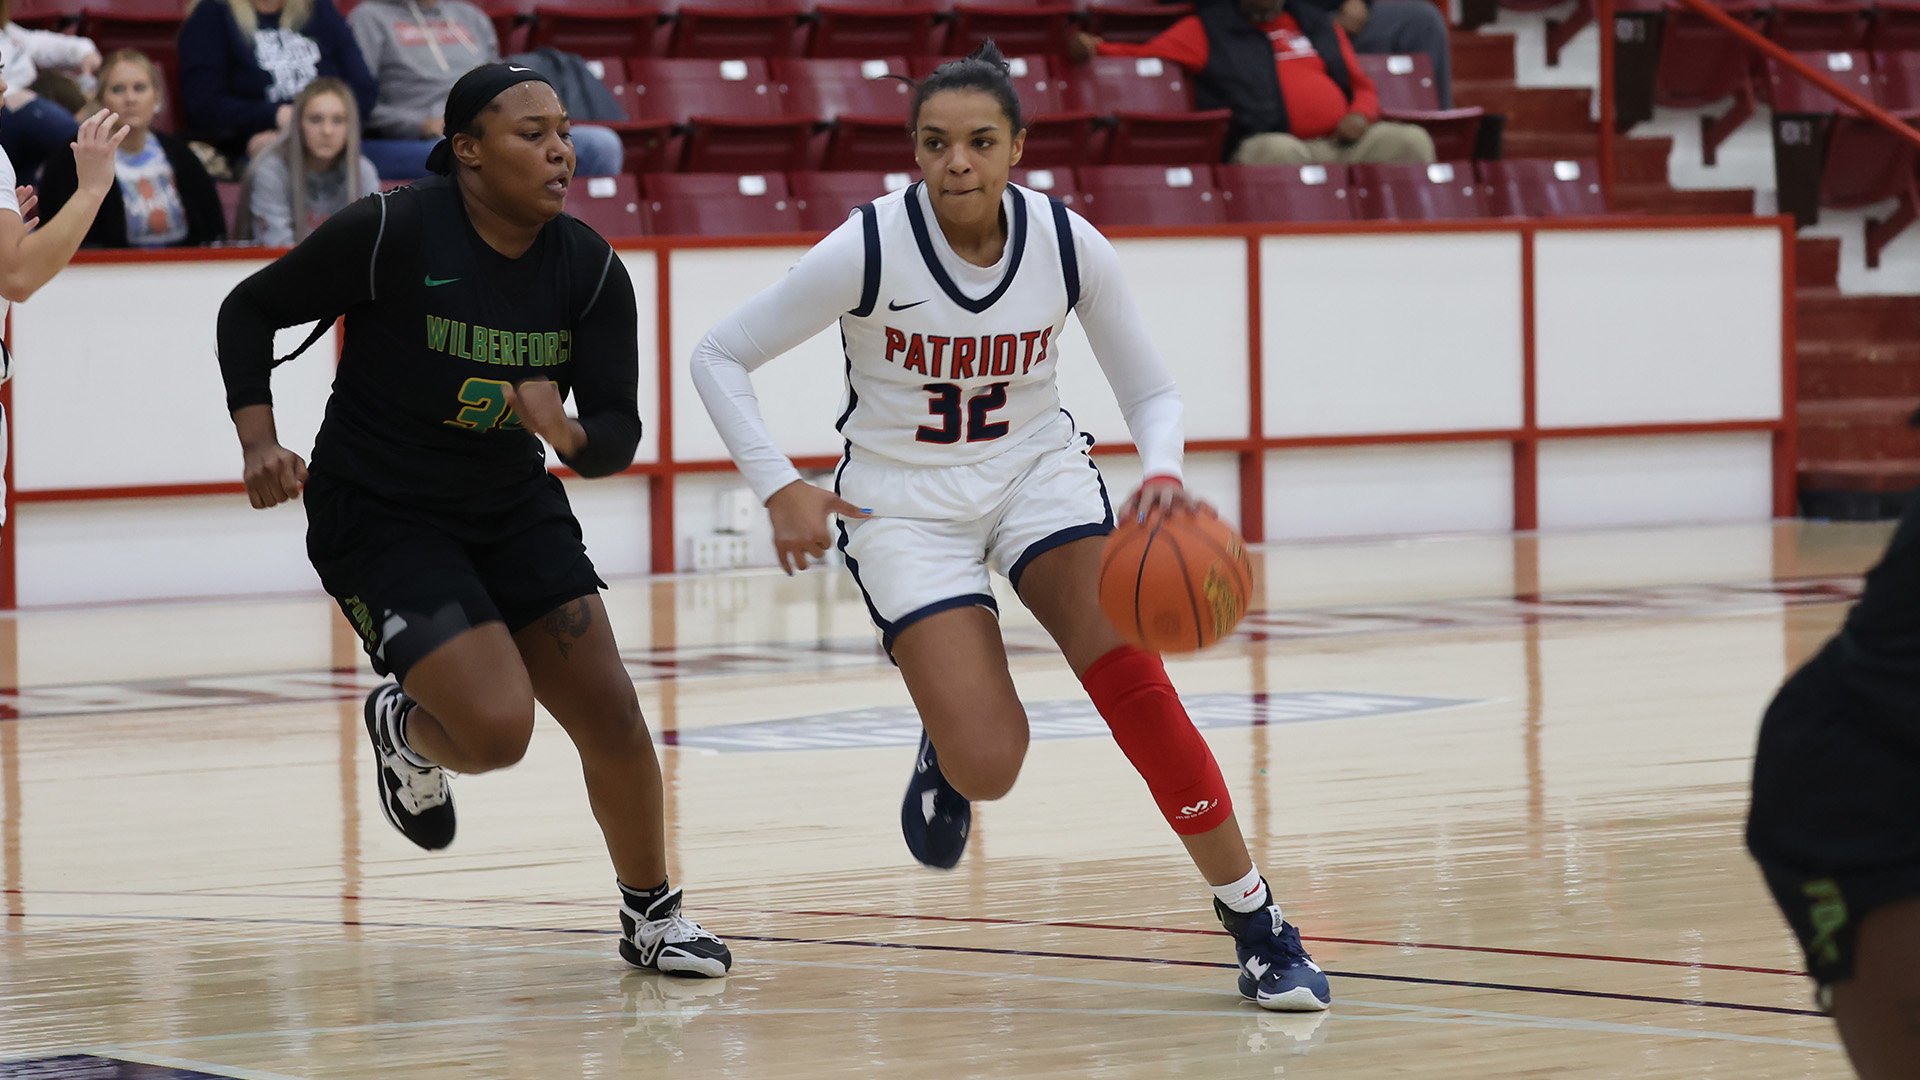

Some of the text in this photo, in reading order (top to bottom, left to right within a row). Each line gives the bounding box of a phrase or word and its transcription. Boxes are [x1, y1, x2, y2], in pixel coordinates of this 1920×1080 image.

[426, 314, 572, 367] WILBERFORC
[884, 325, 1054, 380] PATRIOTS
[443, 377, 559, 432] 3
[915, 381, 1010, 445] 32
